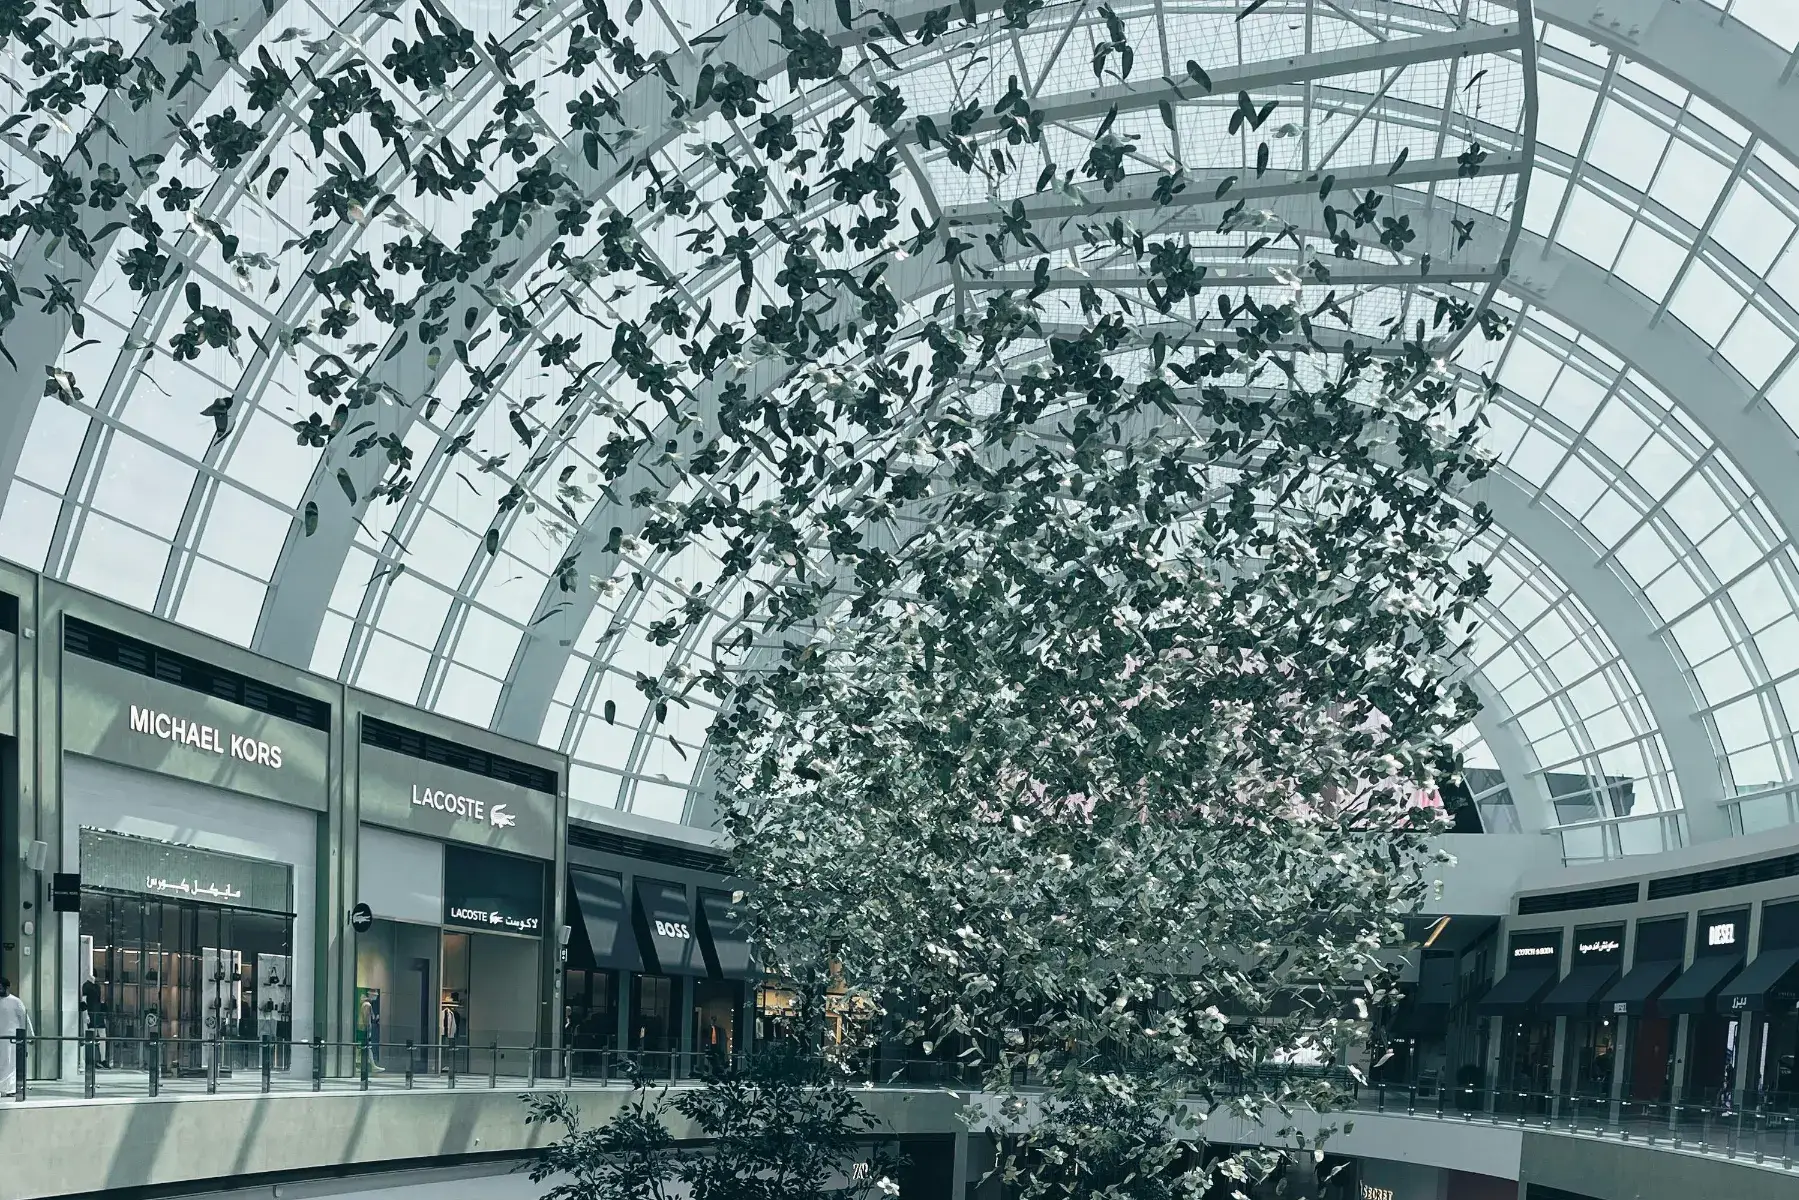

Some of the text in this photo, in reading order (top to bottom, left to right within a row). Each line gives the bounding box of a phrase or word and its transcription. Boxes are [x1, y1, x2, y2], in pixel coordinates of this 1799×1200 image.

[130, 704, 282, 769] MICHAEL KORS
[412, 784, 484, 820] LACOSTE
[146, 875, 240, 899] مايكل كورس
[451, 907, 488, 922] LACOSTE
[505, 916, 539, 930] لاكوست
[655, 920, 690, 939] BOSS
[1708, 923, 1735, 946] DIESEL
